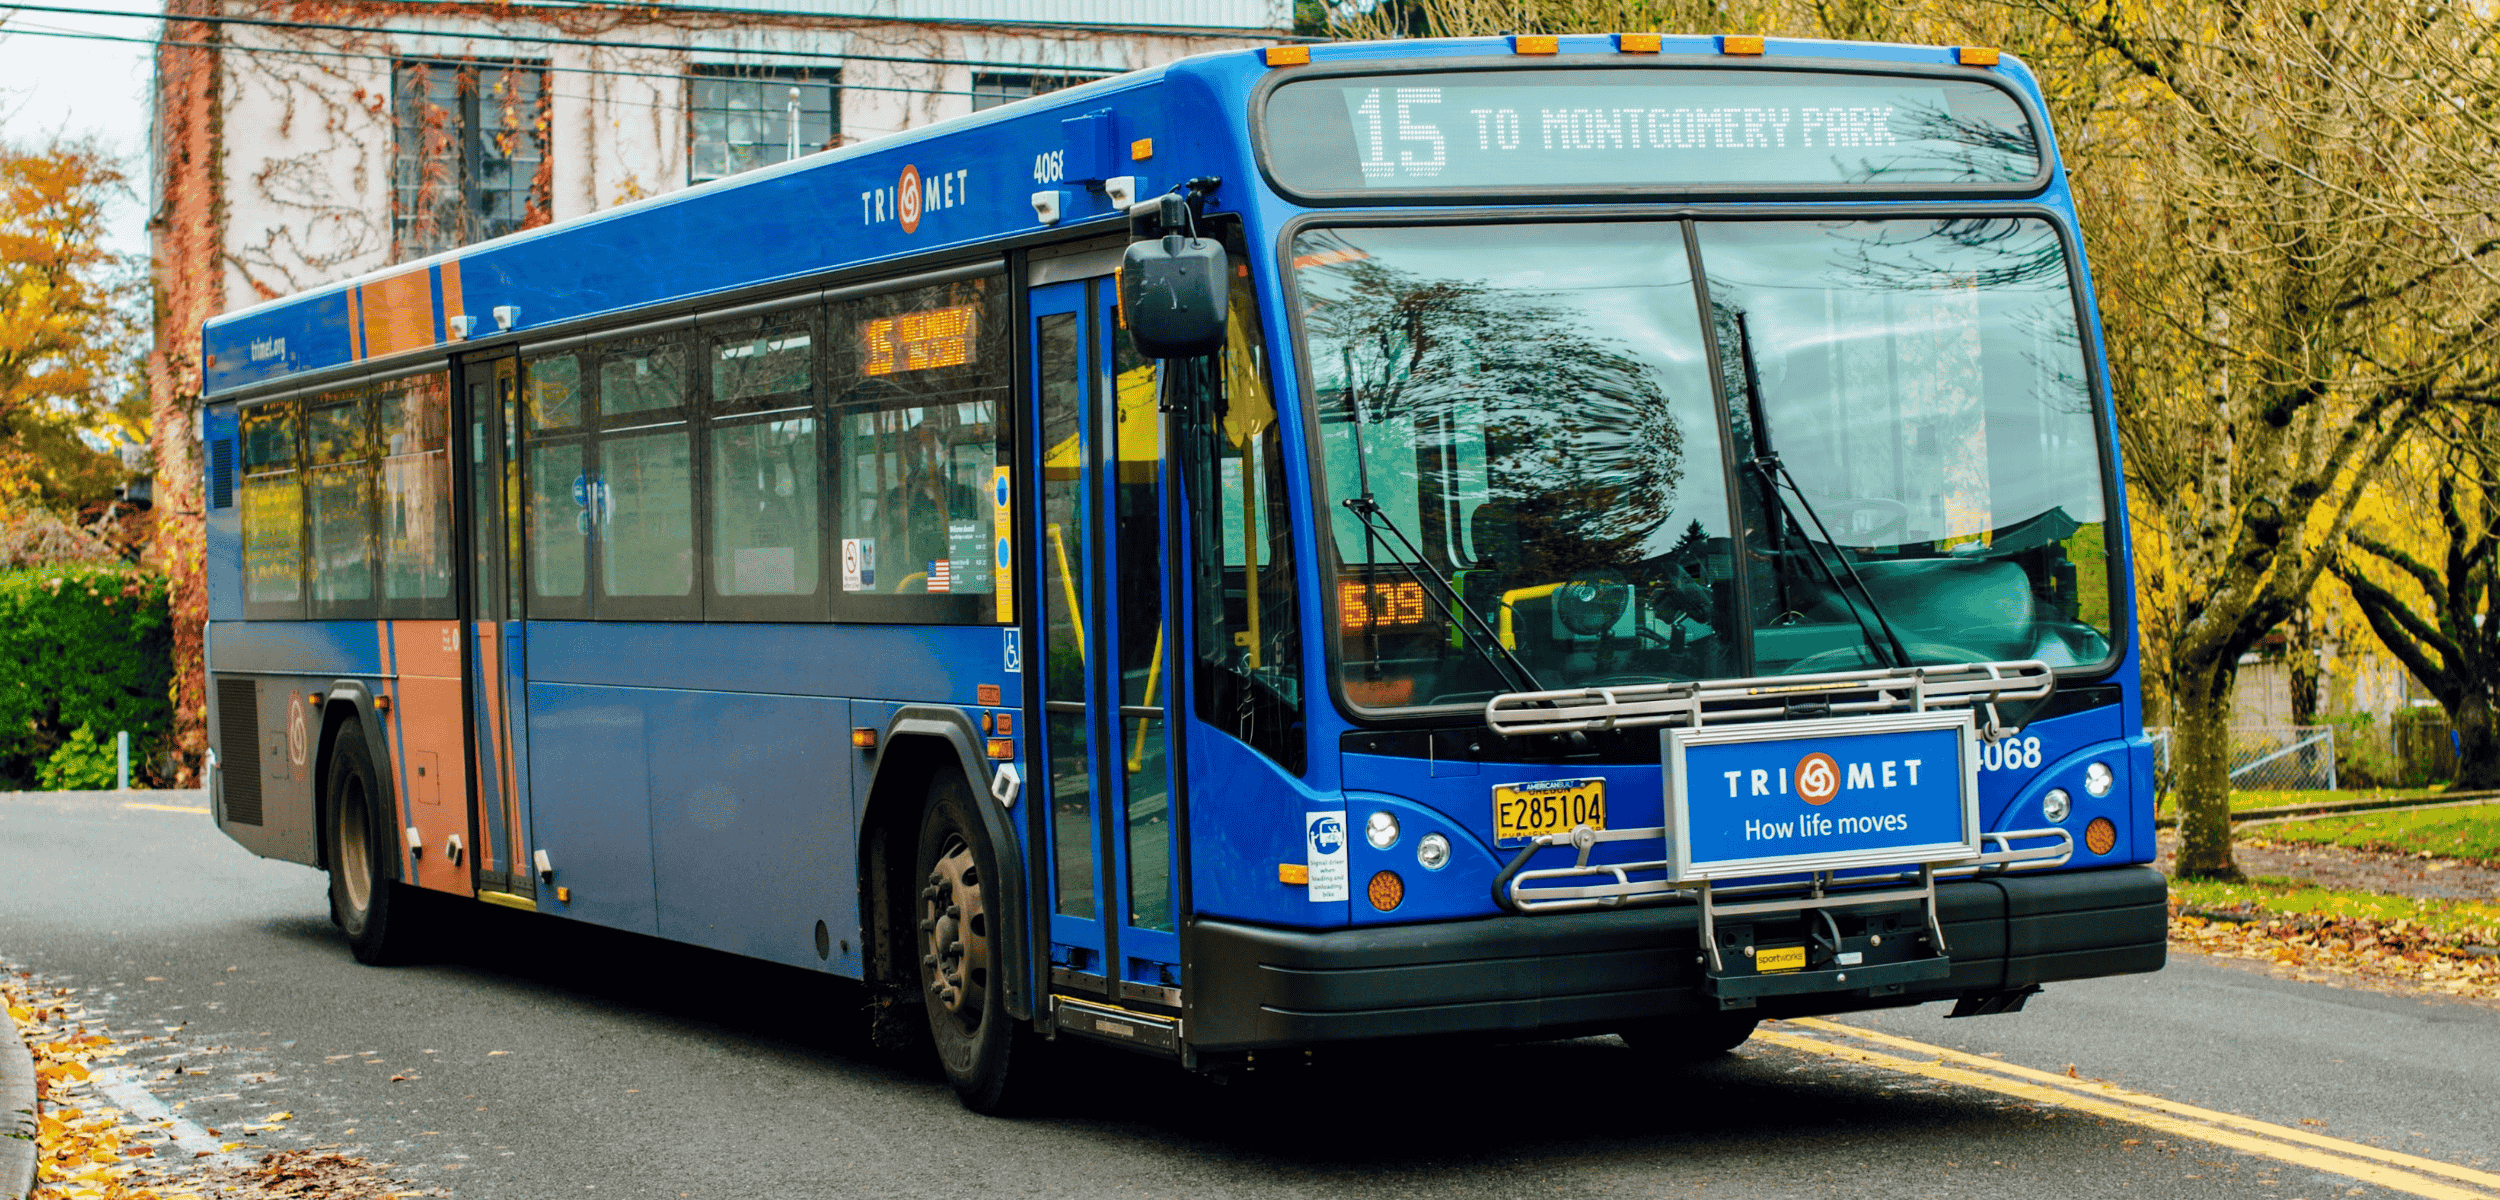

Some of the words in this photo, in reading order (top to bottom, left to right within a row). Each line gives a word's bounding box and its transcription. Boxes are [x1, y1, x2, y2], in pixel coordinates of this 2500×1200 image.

[1358, 87, 1446, 177] 15
[1471, 108, 1519, 149] TO
[1541, 108, 1790, 149] MONTGOMERY
[1802, 107, 1895, 147] PARK
[251, 335, 286, 361] trimet.org
[868, 320, 893, 375] 15
[1500, 793, 1601, 830] E285104
[1745, 819, 1794, 841] How
[1800, 813, 1832, 837] life
[1838, 813, 1908, 834] moves
[1758, 952, 1803, 964] sportworks
